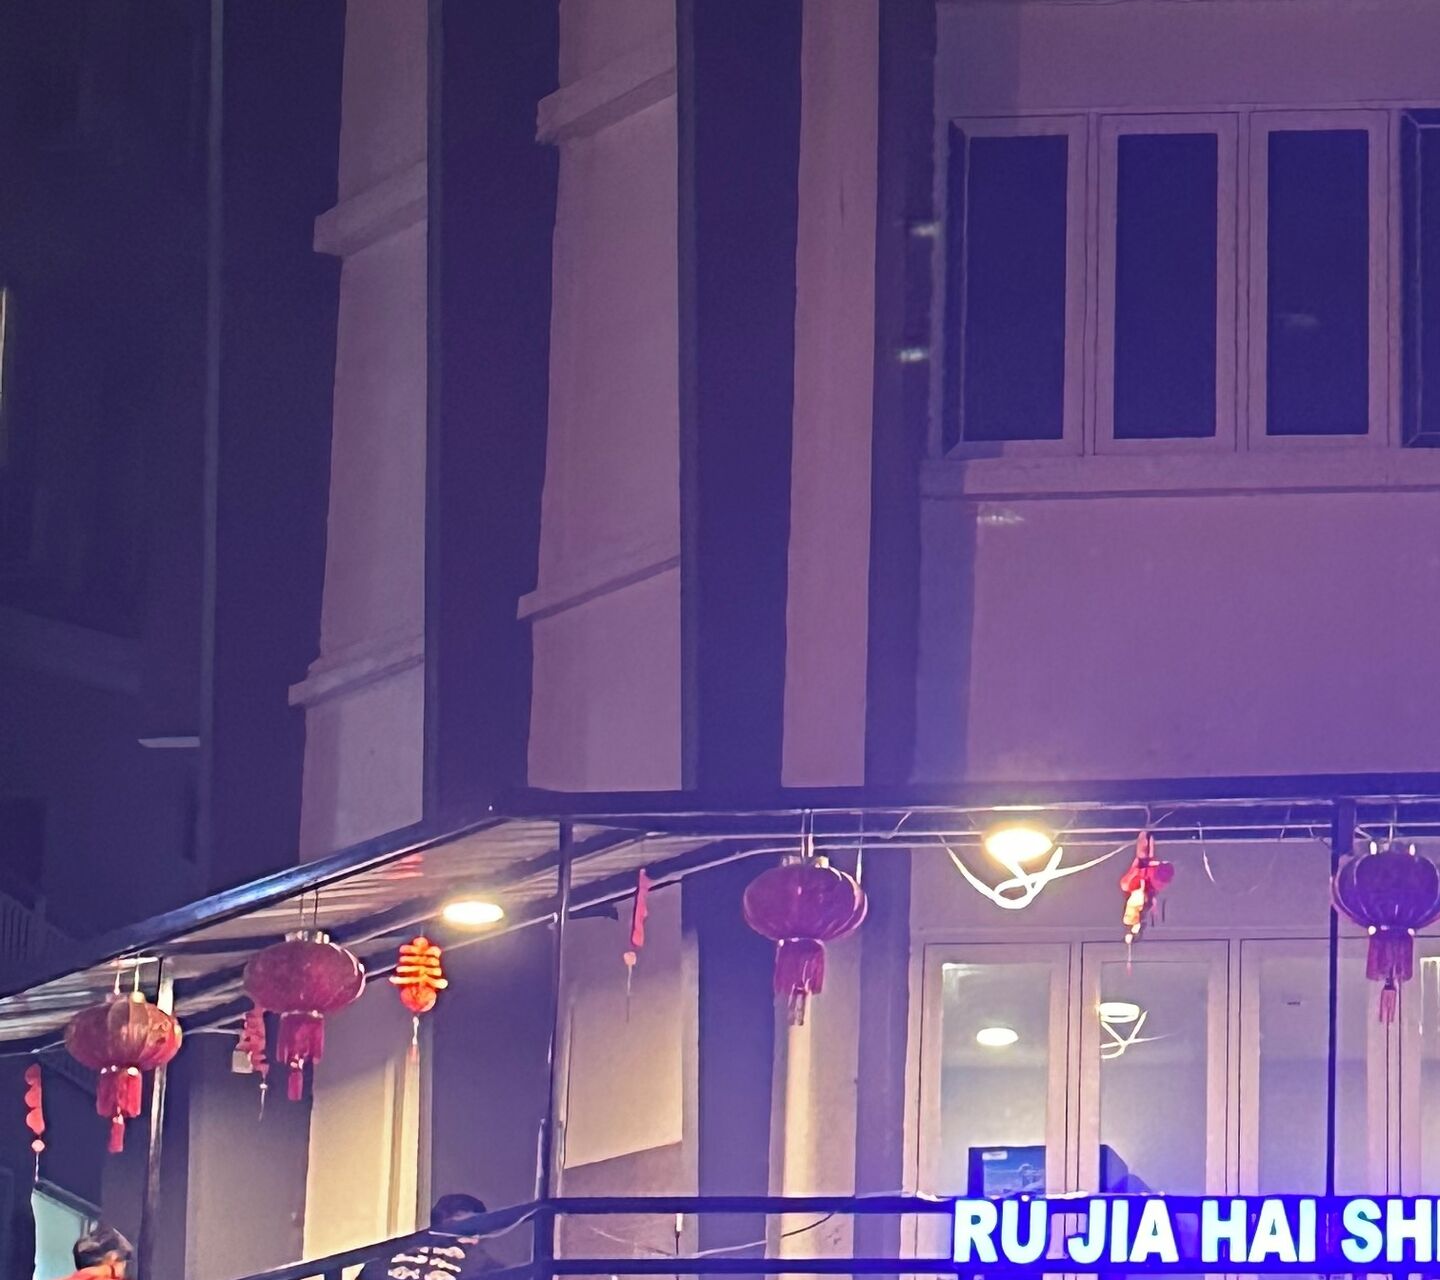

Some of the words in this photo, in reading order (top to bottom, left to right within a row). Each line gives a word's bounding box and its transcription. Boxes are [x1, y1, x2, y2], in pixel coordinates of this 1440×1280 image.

[953, 1198, 1047, 1263] RU
[1066, 1198, 1178, 1263] JIA
[1200, 1198, 1316, 1263] HAI
